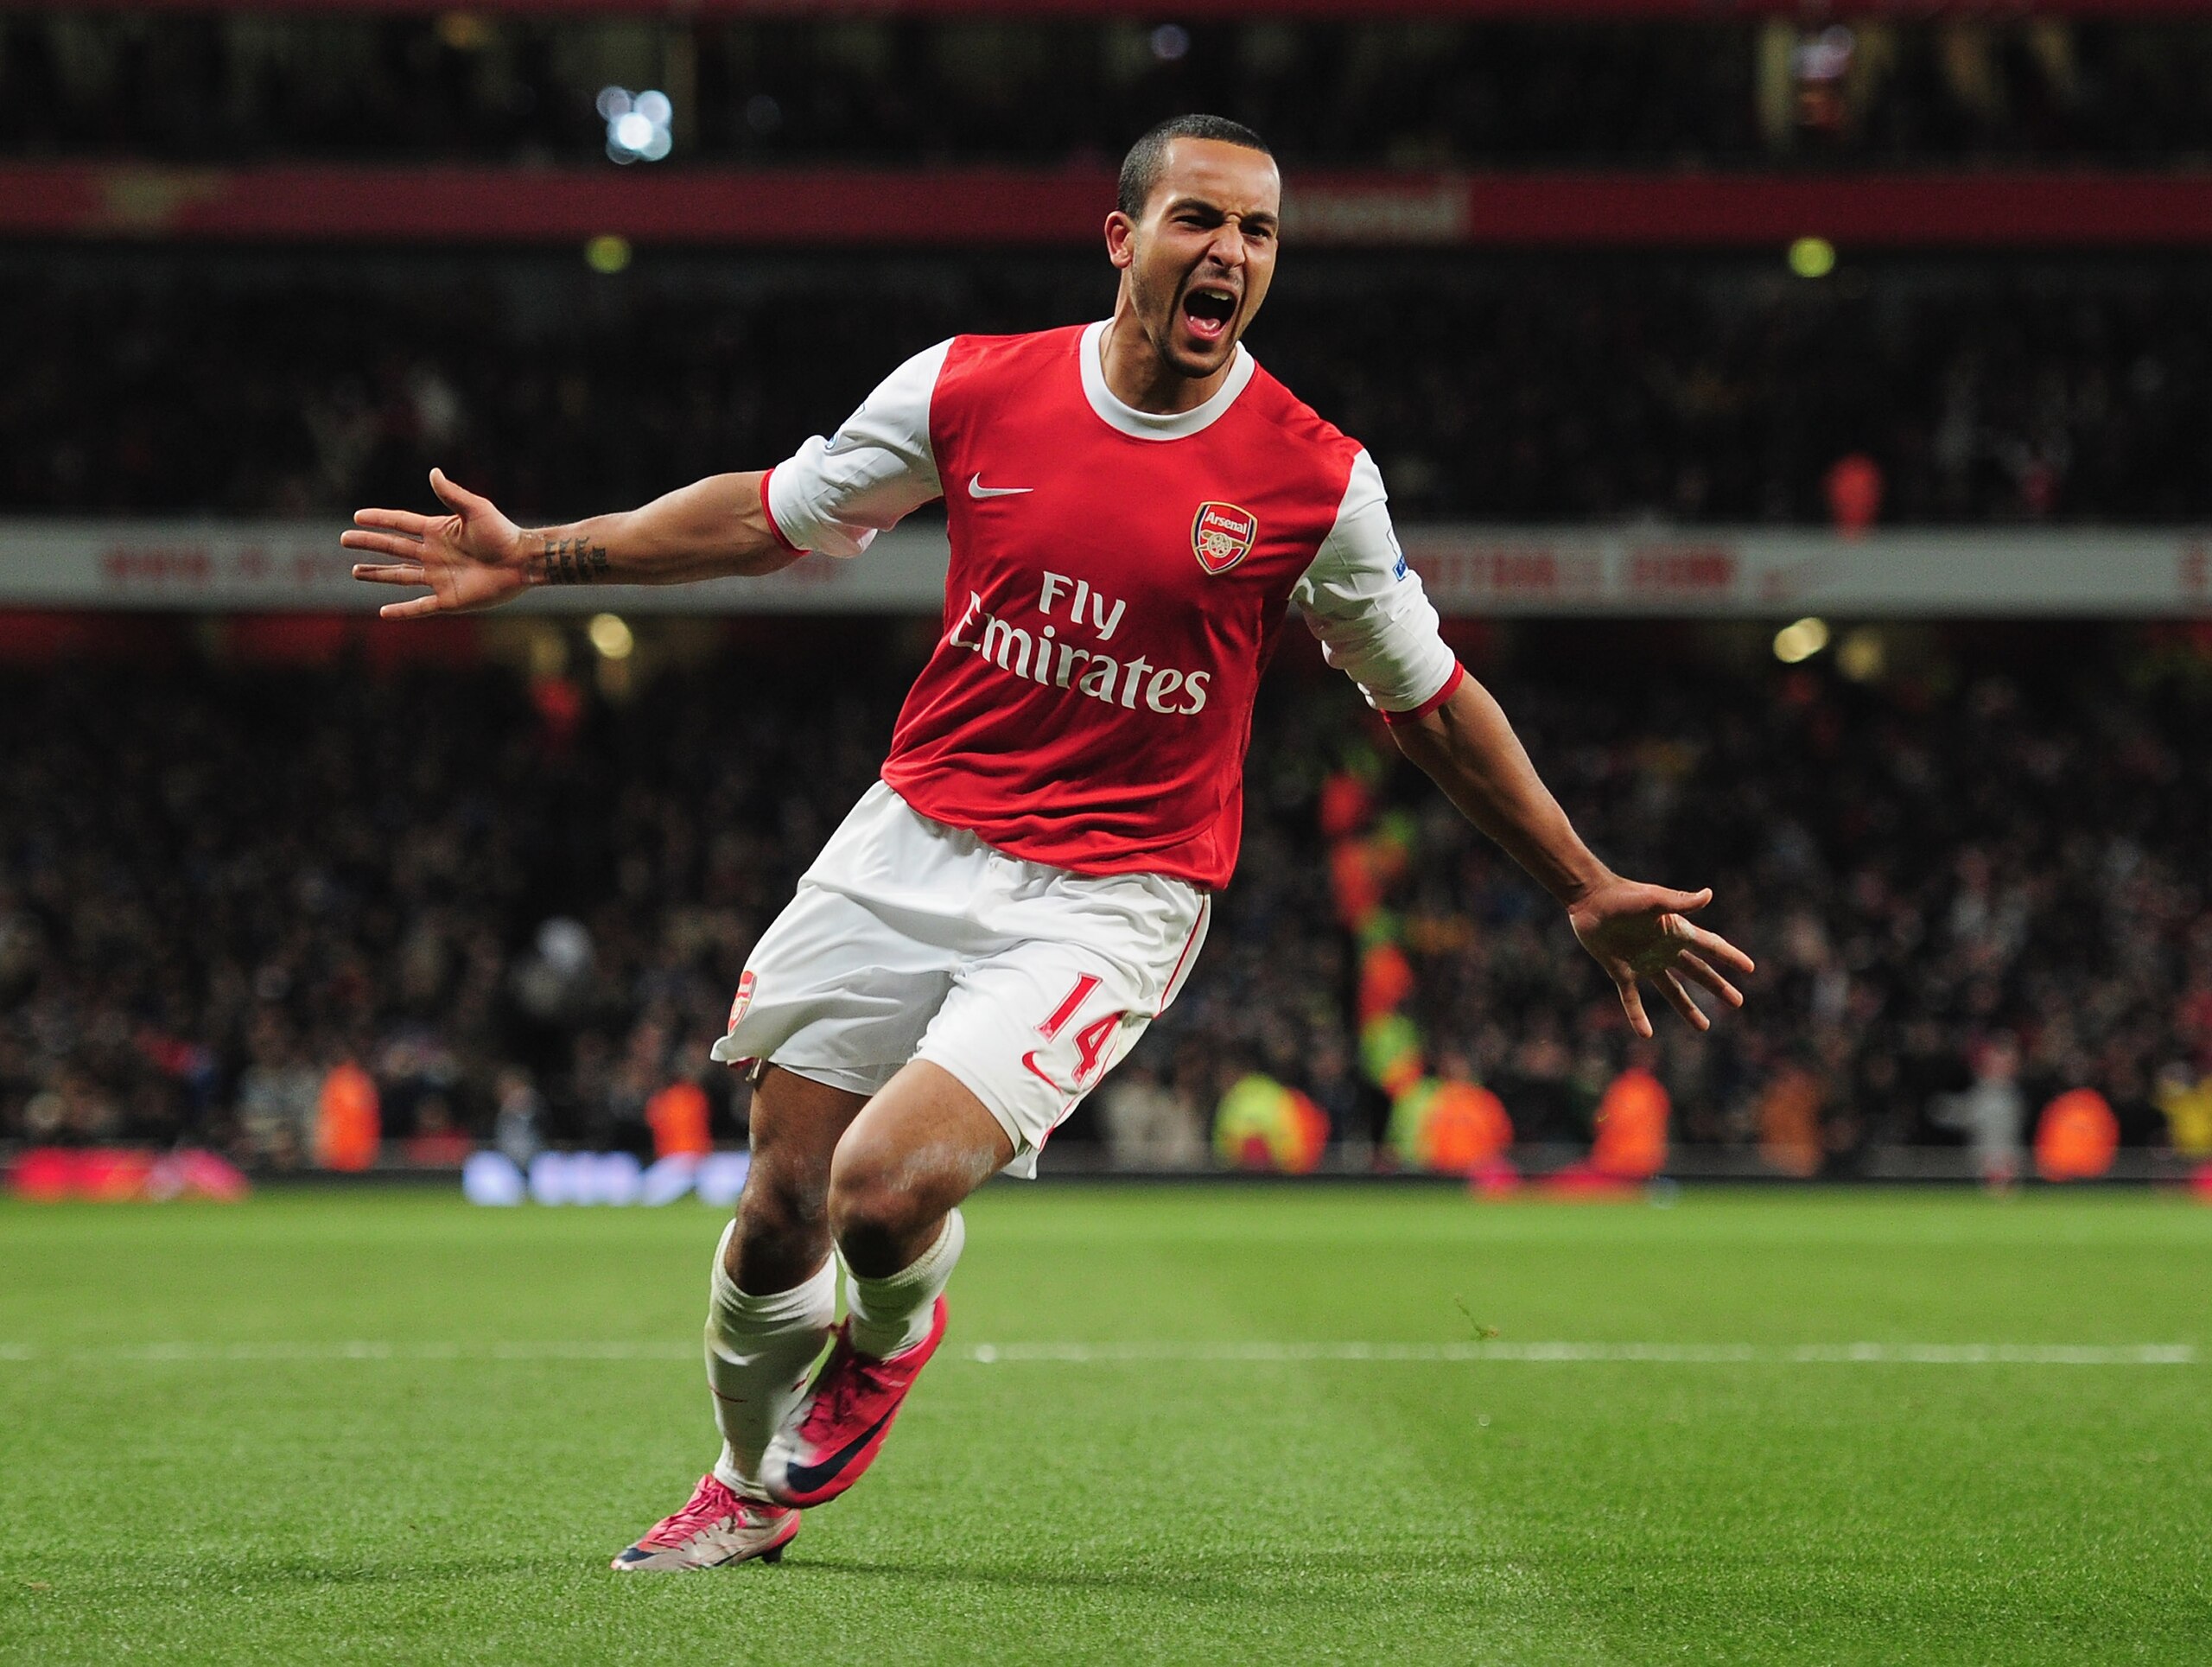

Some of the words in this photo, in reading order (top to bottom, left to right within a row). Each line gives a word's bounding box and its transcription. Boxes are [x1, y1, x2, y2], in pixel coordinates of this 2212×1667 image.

[1205, 512, 1248, 535] Arsenal
[1039, 570, 1126, 641] Fly
[950, 590, 1211, 715] Emirates
[1033, 972, 1128, 1086] 14
